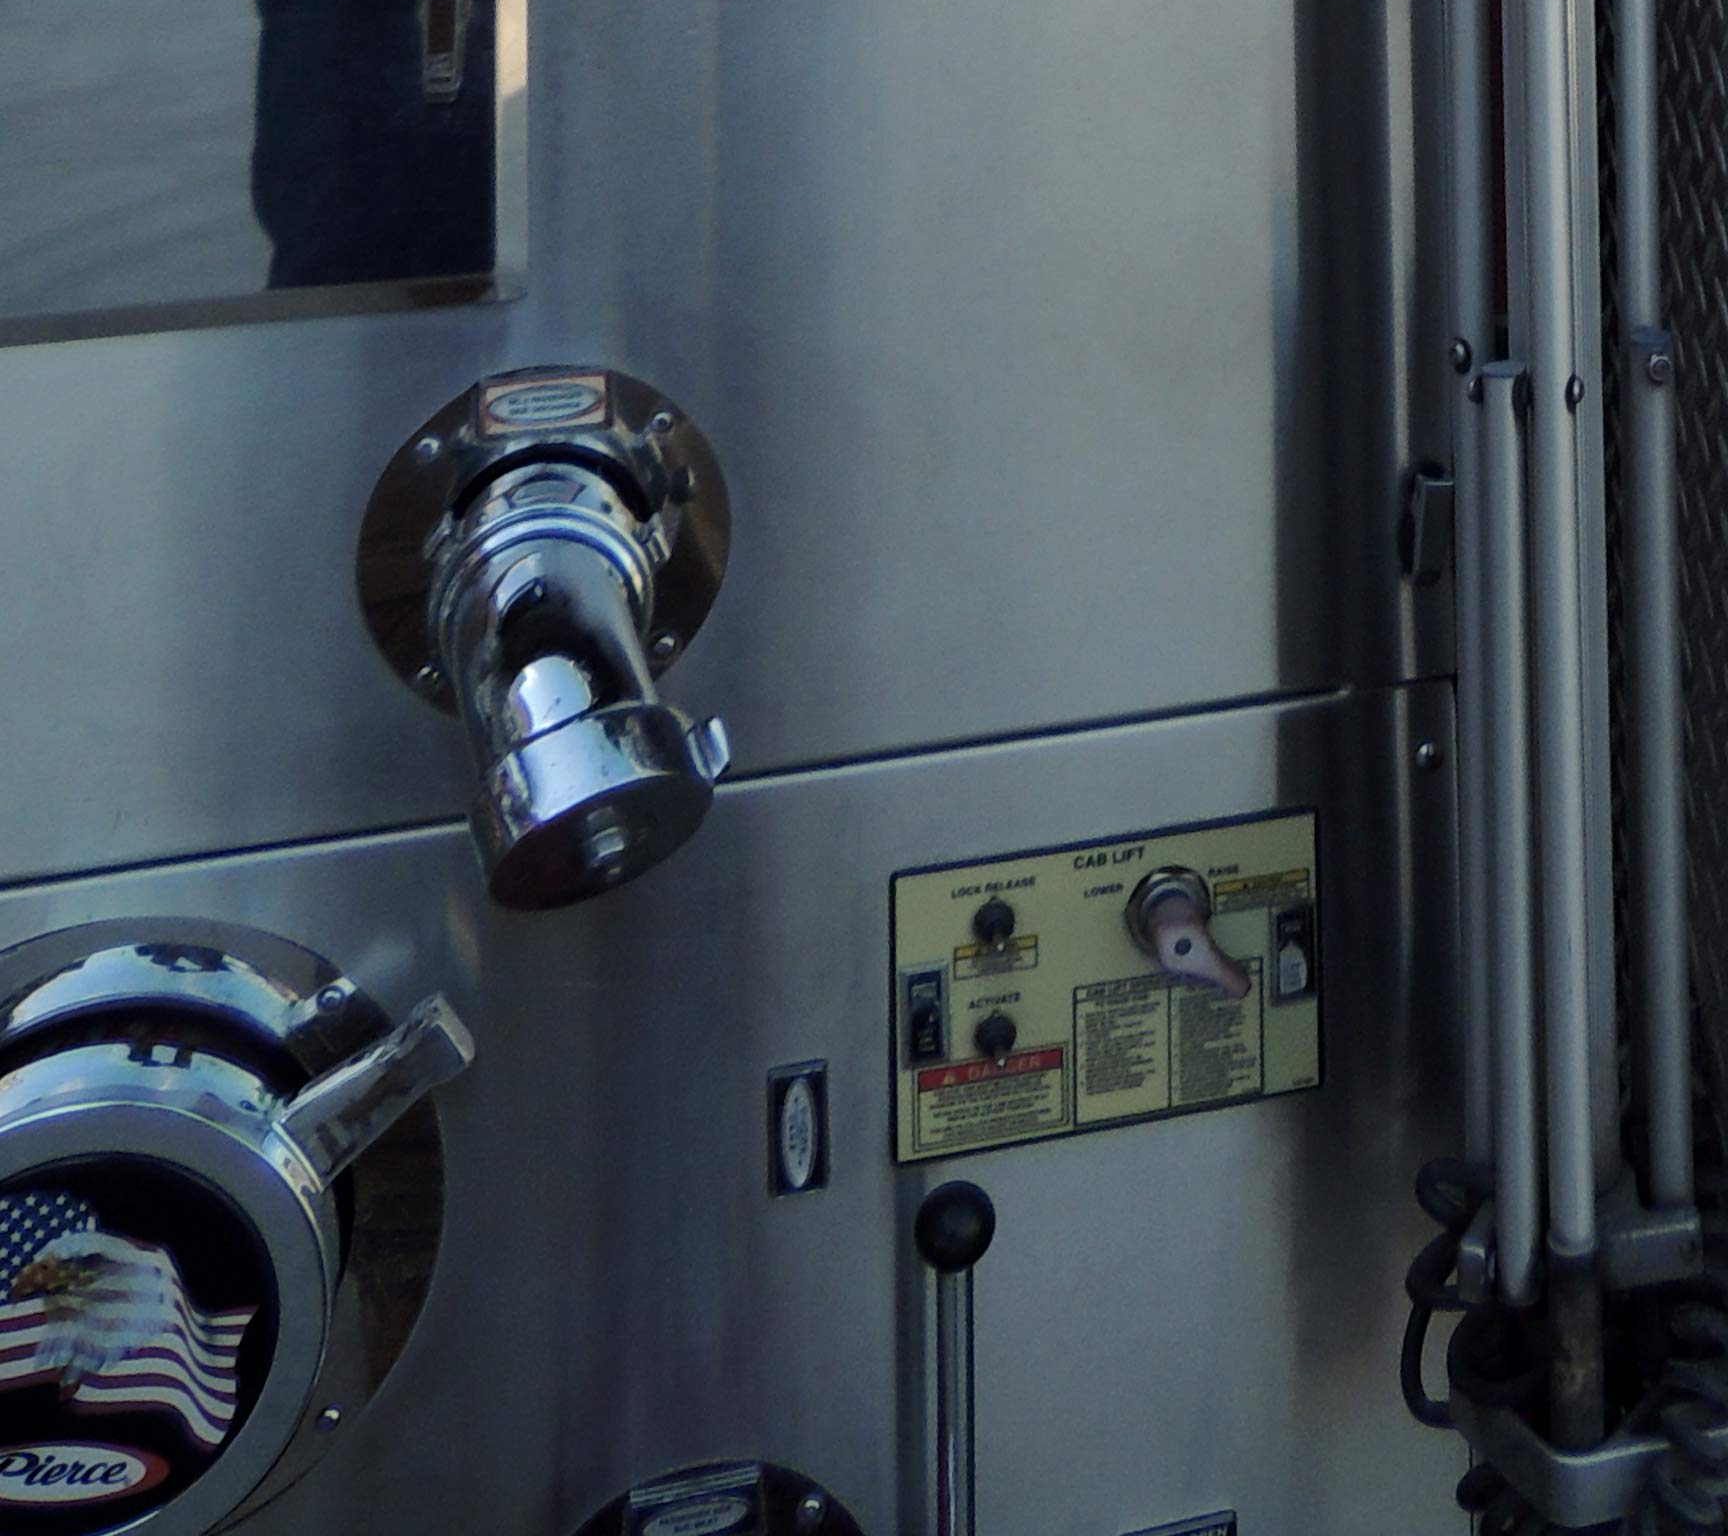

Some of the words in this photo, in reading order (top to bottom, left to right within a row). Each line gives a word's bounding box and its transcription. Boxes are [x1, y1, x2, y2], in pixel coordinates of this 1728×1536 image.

[1073, 851, 1107, 870] CAB
[1111, 846, 1146, 865] LIFT
[951, 885, 982, 898] LOCK
[984, 876, 1036, 894] RELEASE
[1083, 883, 1124, 898] LOWER
[968, 991, 1021, 1008] ACTIVATE
[967, 1056, 1041, 1079] DAGER
[0, 1451, 128, 1487] Pierce
